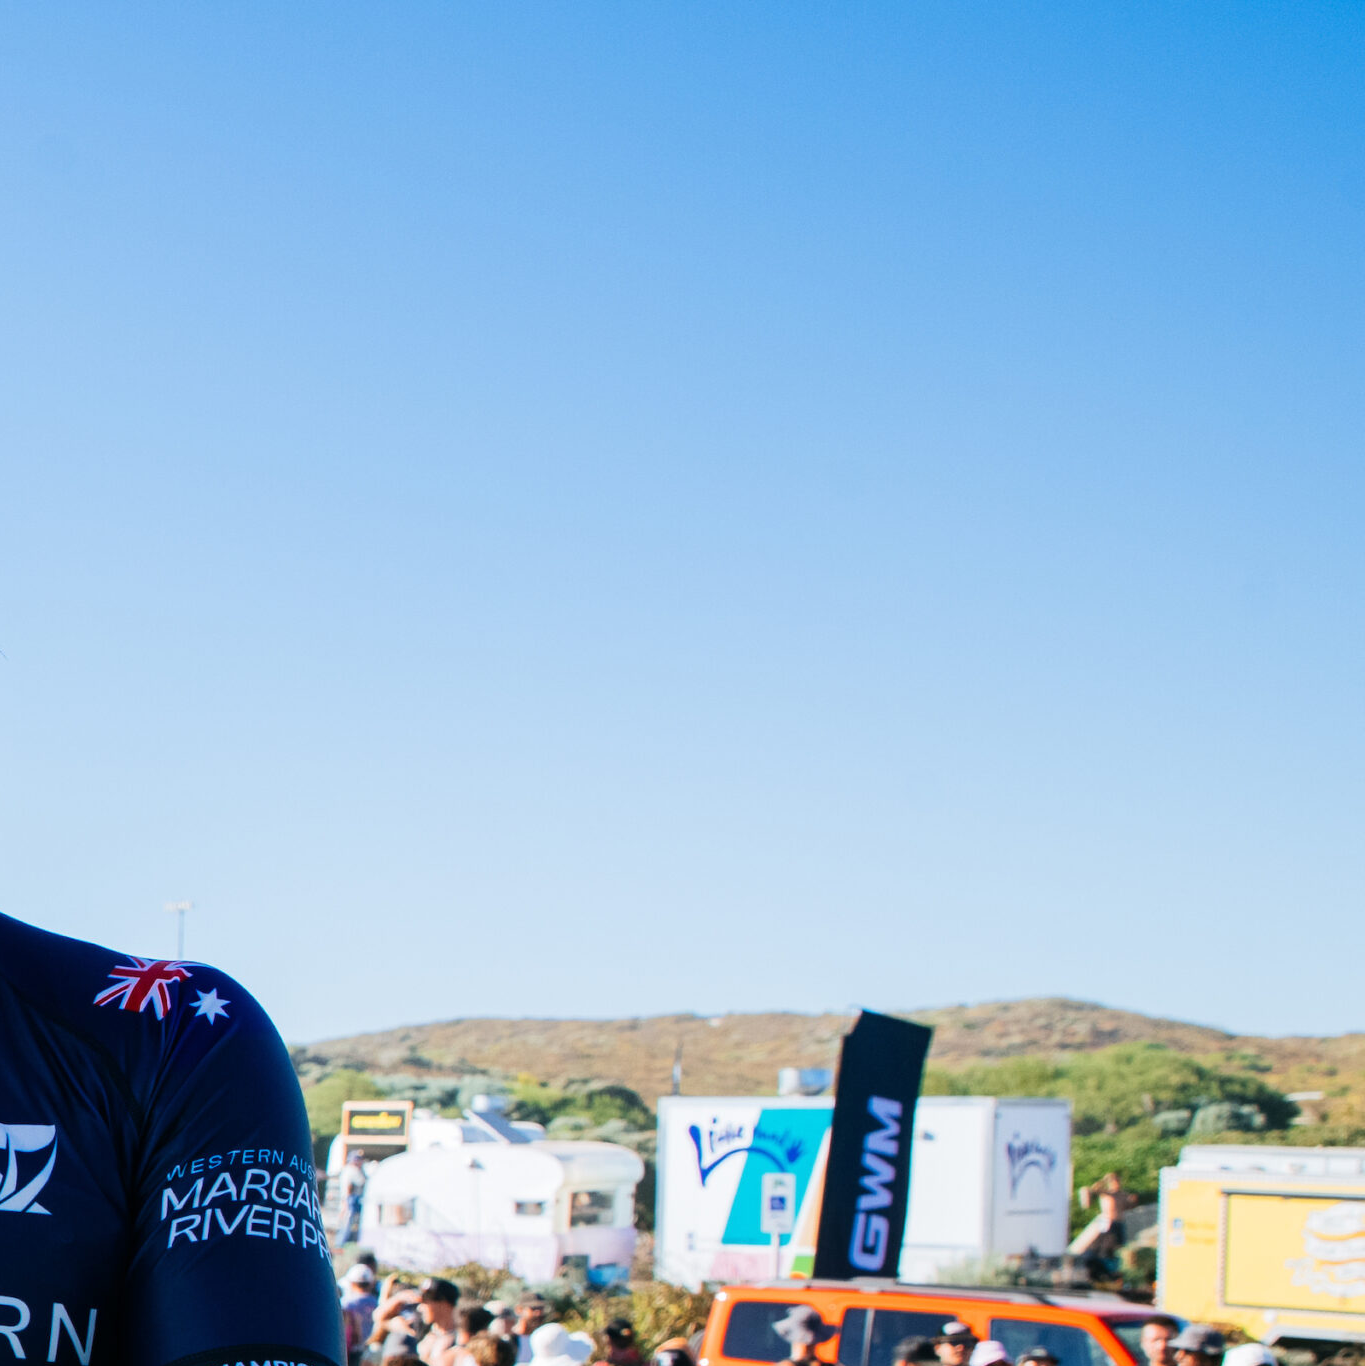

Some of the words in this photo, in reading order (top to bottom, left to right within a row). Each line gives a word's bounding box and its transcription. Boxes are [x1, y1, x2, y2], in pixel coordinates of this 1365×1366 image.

[166, 1149, 284, 1181] WESTERN
[849, 1095, 903, 1273] GWM
[167, 1204, 295, 1249] RIVER
[302, 1219, 333, 1267] PR
